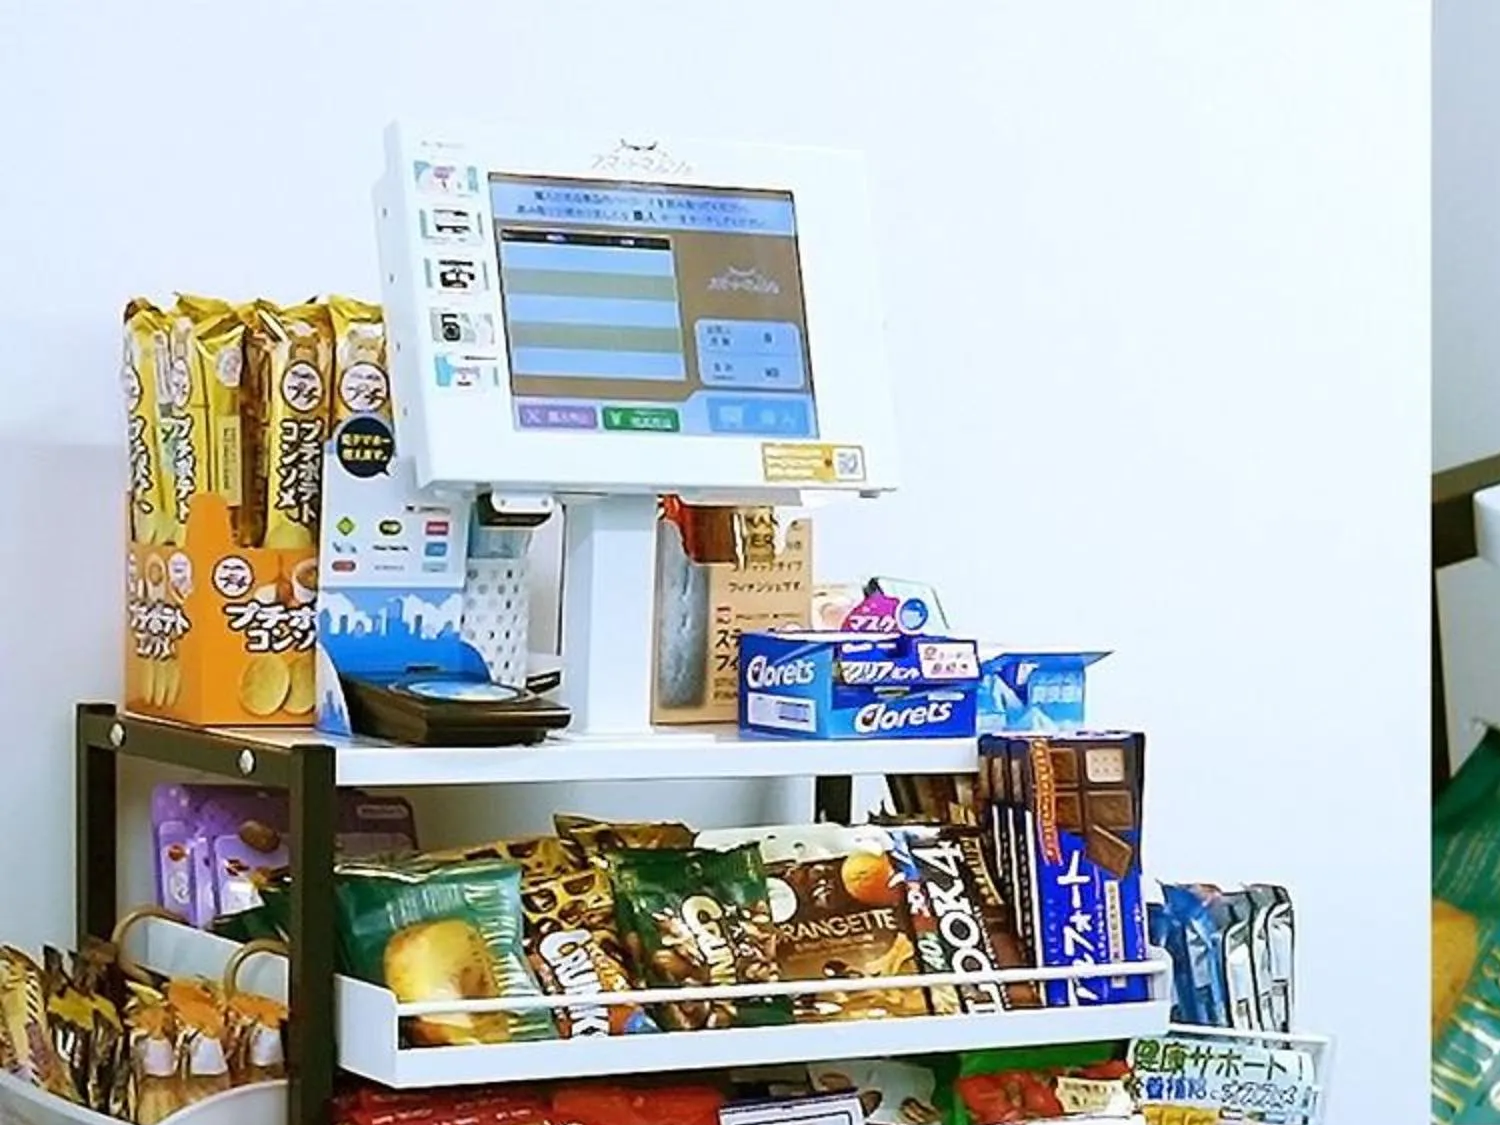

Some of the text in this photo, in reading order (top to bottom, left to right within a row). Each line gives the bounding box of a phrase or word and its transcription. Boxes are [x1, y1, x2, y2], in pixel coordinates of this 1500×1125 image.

[746, 655, 816, 690] Clorets
[854, 700, 953, 736] Clorets
[776, 906, 898, 944] RANGETTE
